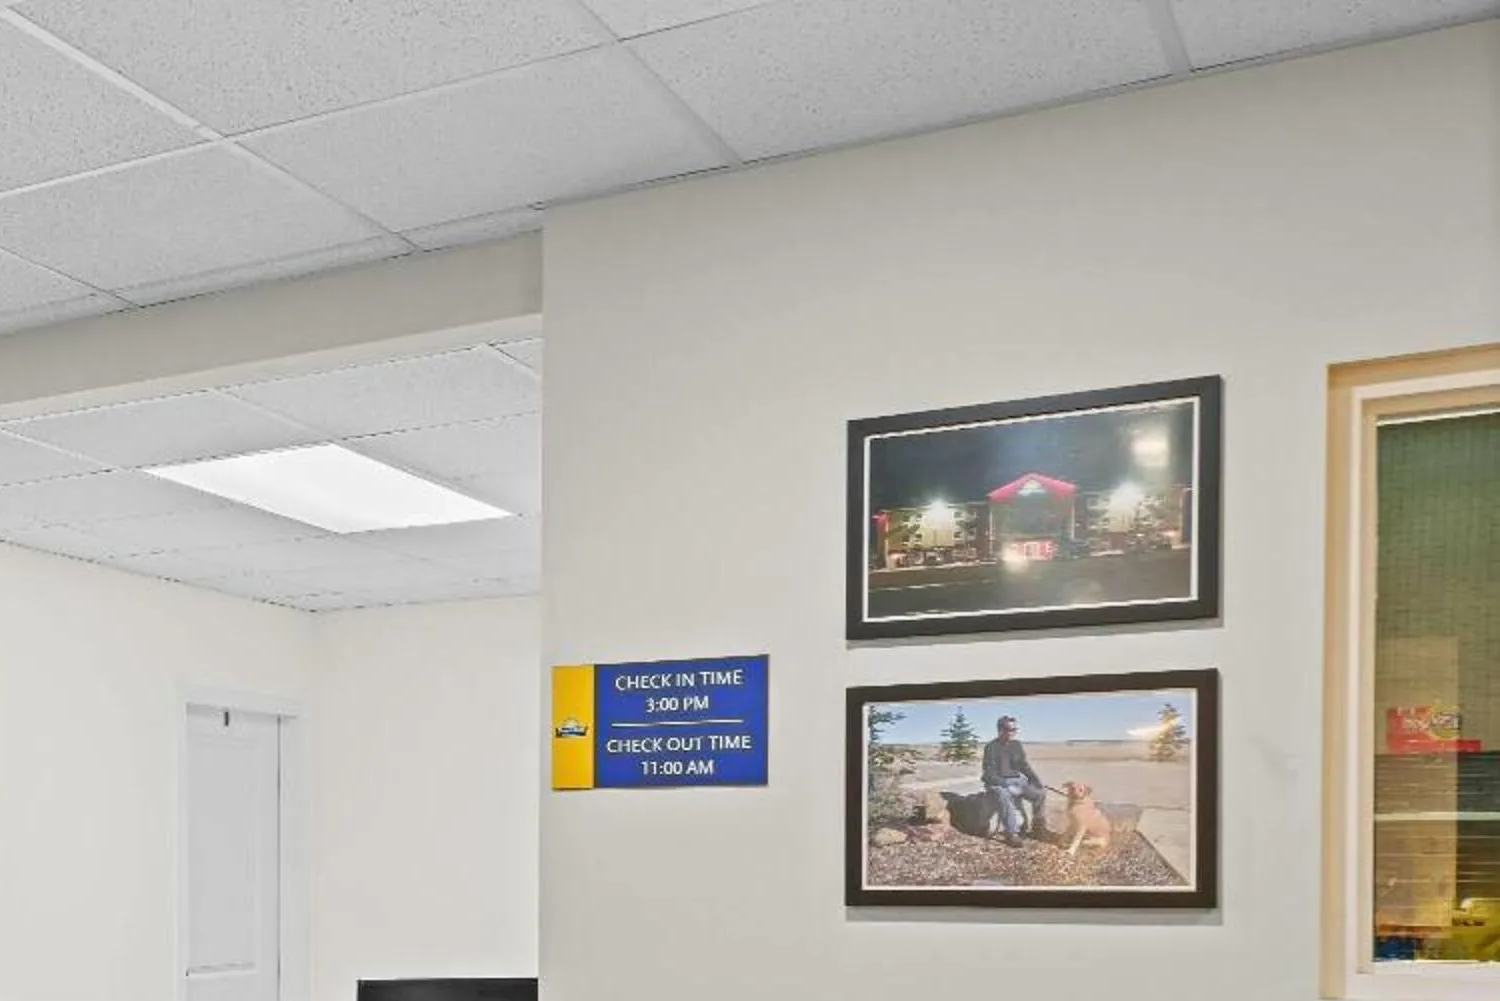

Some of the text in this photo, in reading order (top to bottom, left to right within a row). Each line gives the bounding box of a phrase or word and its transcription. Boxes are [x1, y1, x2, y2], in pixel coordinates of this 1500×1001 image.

[614, 669, 743, 691] CHECK IN TIME
[646, 696, 709, 713] 3:00 PM
[606, 735, 752, 753] CHECK OUT TIME
[641, 759, 715, 776] 11:00 AM
